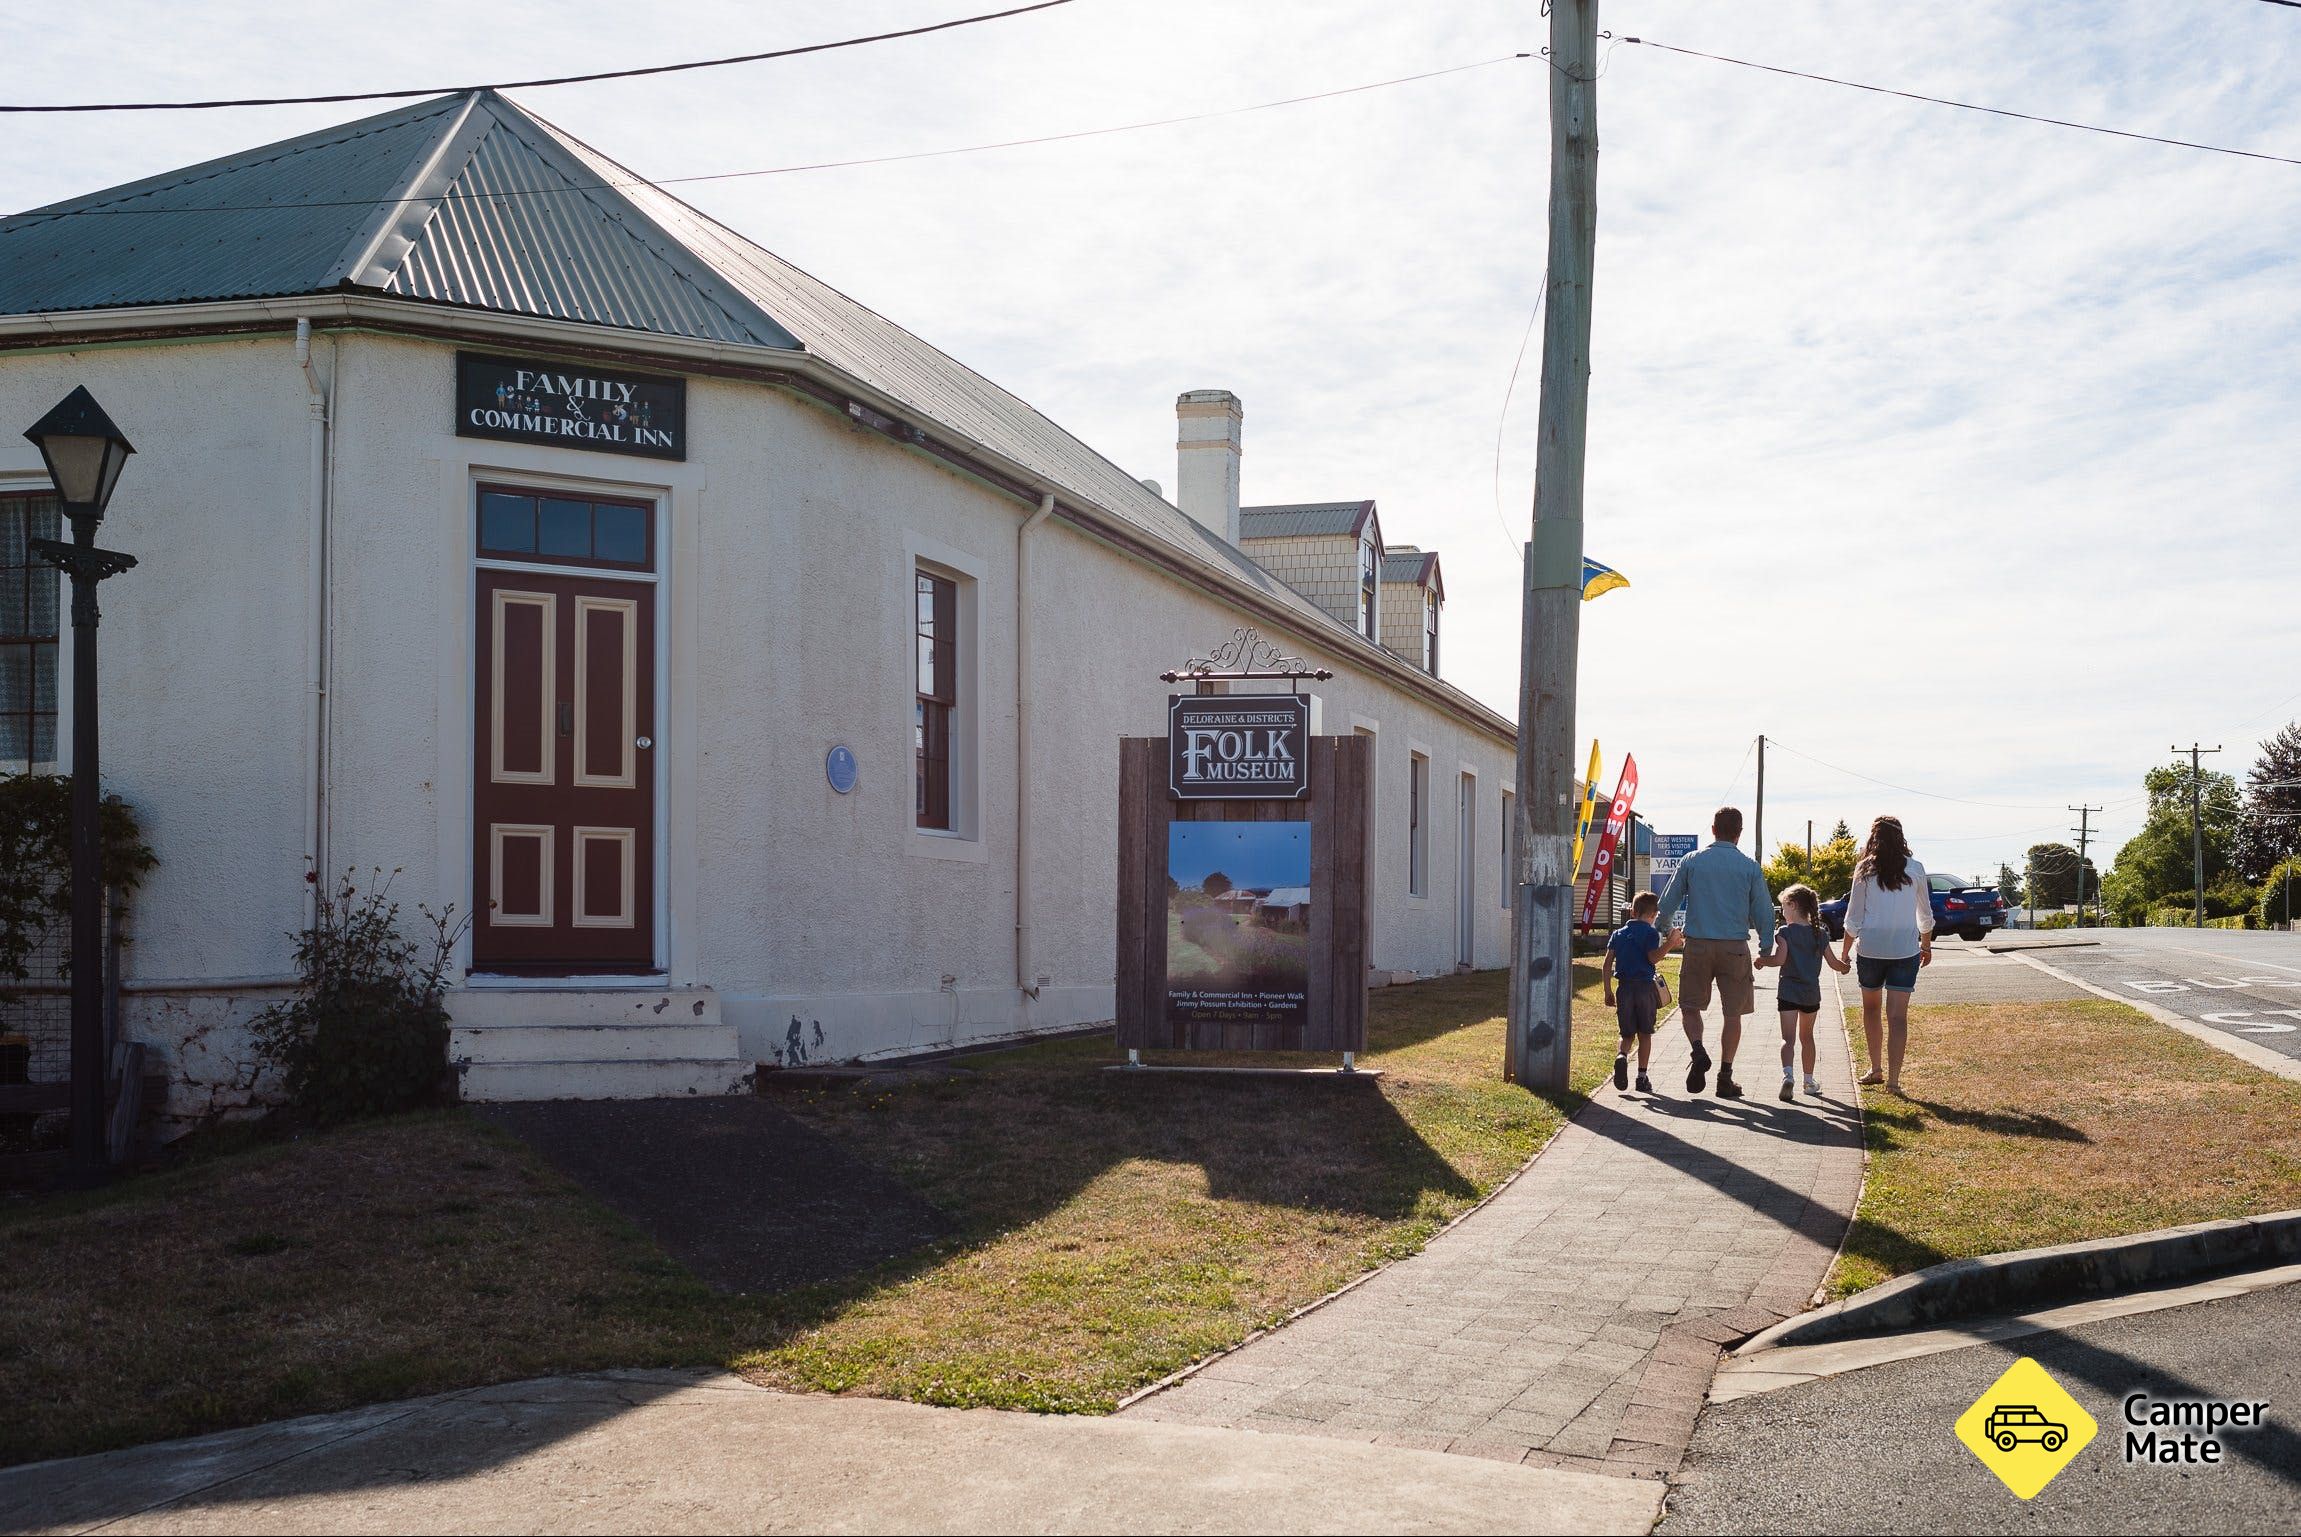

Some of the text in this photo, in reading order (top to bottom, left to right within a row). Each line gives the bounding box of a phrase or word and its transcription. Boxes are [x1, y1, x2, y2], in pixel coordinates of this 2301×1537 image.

[516, 370, 638, 403] FAMILY
[566, 395, 591, 421] &
[470, 408, 672, 448] COMMERCIAL INN
[1183, 713, 1295, 724] DELORAINE & DISTRICTS
[1182, 730, 1295, 780] FOLK
[1206, 762, 1295, 780] MUSEUM
[1606, 779, 1636, 836] NOW
[2121, 976, 2301, 993] BUS
[1168, 991, 1191, 999] Family
[1199, 991, 1240, 999] Commercial
[1176, 1000, 1199, 1009] Jimmy
[1192, 1011, 1211, 1020] Open
